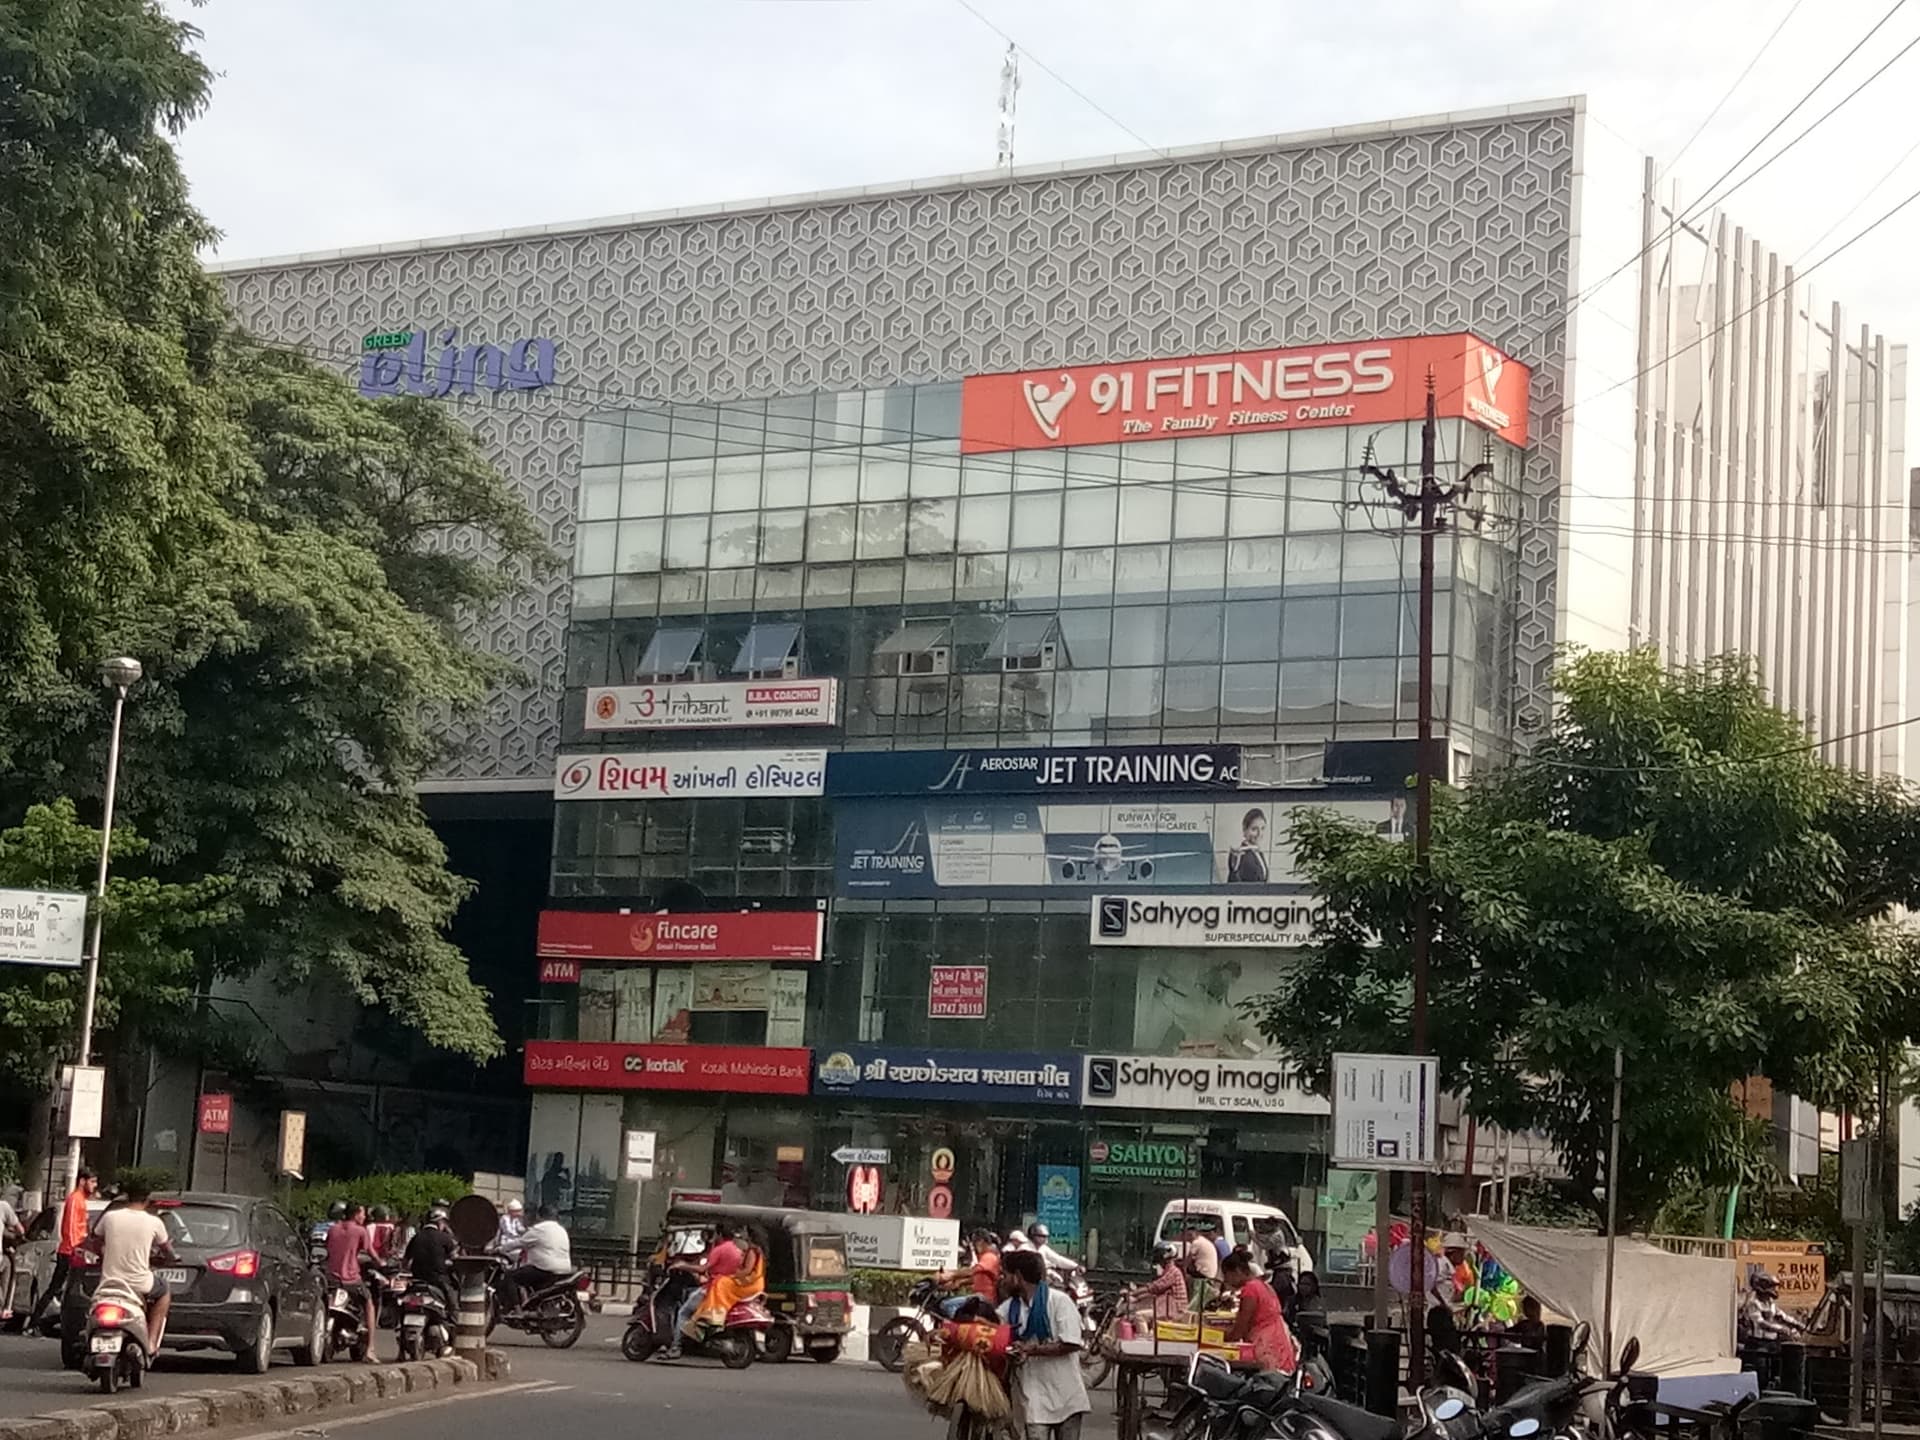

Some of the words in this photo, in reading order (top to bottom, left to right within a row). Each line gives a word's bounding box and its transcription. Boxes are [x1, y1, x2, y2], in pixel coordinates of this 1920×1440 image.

[363, 331, 412, 350] GREEN
[1090, 371, 1134, 414] 91
[1145, 349, 1395, 411] FITNESS
[1122, 419, 1152, 434] The
[1160, 414, 1218, 432] Family
[1226, 410, 1289, 426] Fitness
[1296, 403, 1355, 420] Center
[598, 757, 670, 796] શિવમ્
[672, 765, 736, 789] આંખની
[746, 764, 822, 789] હોસ્પિટલ
[980, 757, 1038, 771] AEROSTAR
[1036, 756, 1078, 784] JET
[1084, 754, 1214, 784] TRAINING
[1117, 812, 1156, 822] RUNWAY
[1159, 812, 1177, 821] FOR
[850, 855, 868, 869] JET
[871, 855, 925, 869] TRAINING
[1130, 901, 1220, 929] Sahyog
[657, 921, 719, 939] fincare
[1204, 932, 1292, 943] SUPERSPECIALITY
[543, 962, 575, 978] ATM
[646, 1058, 685, 1073] kotak
[701, 1063, 729, 1075] Kotak
[731, 1063, 777, 1077] Mahindra
[779, 1065, 805, 1078] Bank
[864, 1058, 887, 1081] શ્રી
[1119, 1061, 1210, 1092] Sahyog
[1219, 1096, 1232, 1106] CT
[1264, 1098, 1286, 1108] USG
[203, 1109, 229, 1121] ATM
[1777, 1263, 1785, 1274] 2
[1790, 1263, 1819, 1274] BHK
[1778, 1280, 1819, 1291] READY
